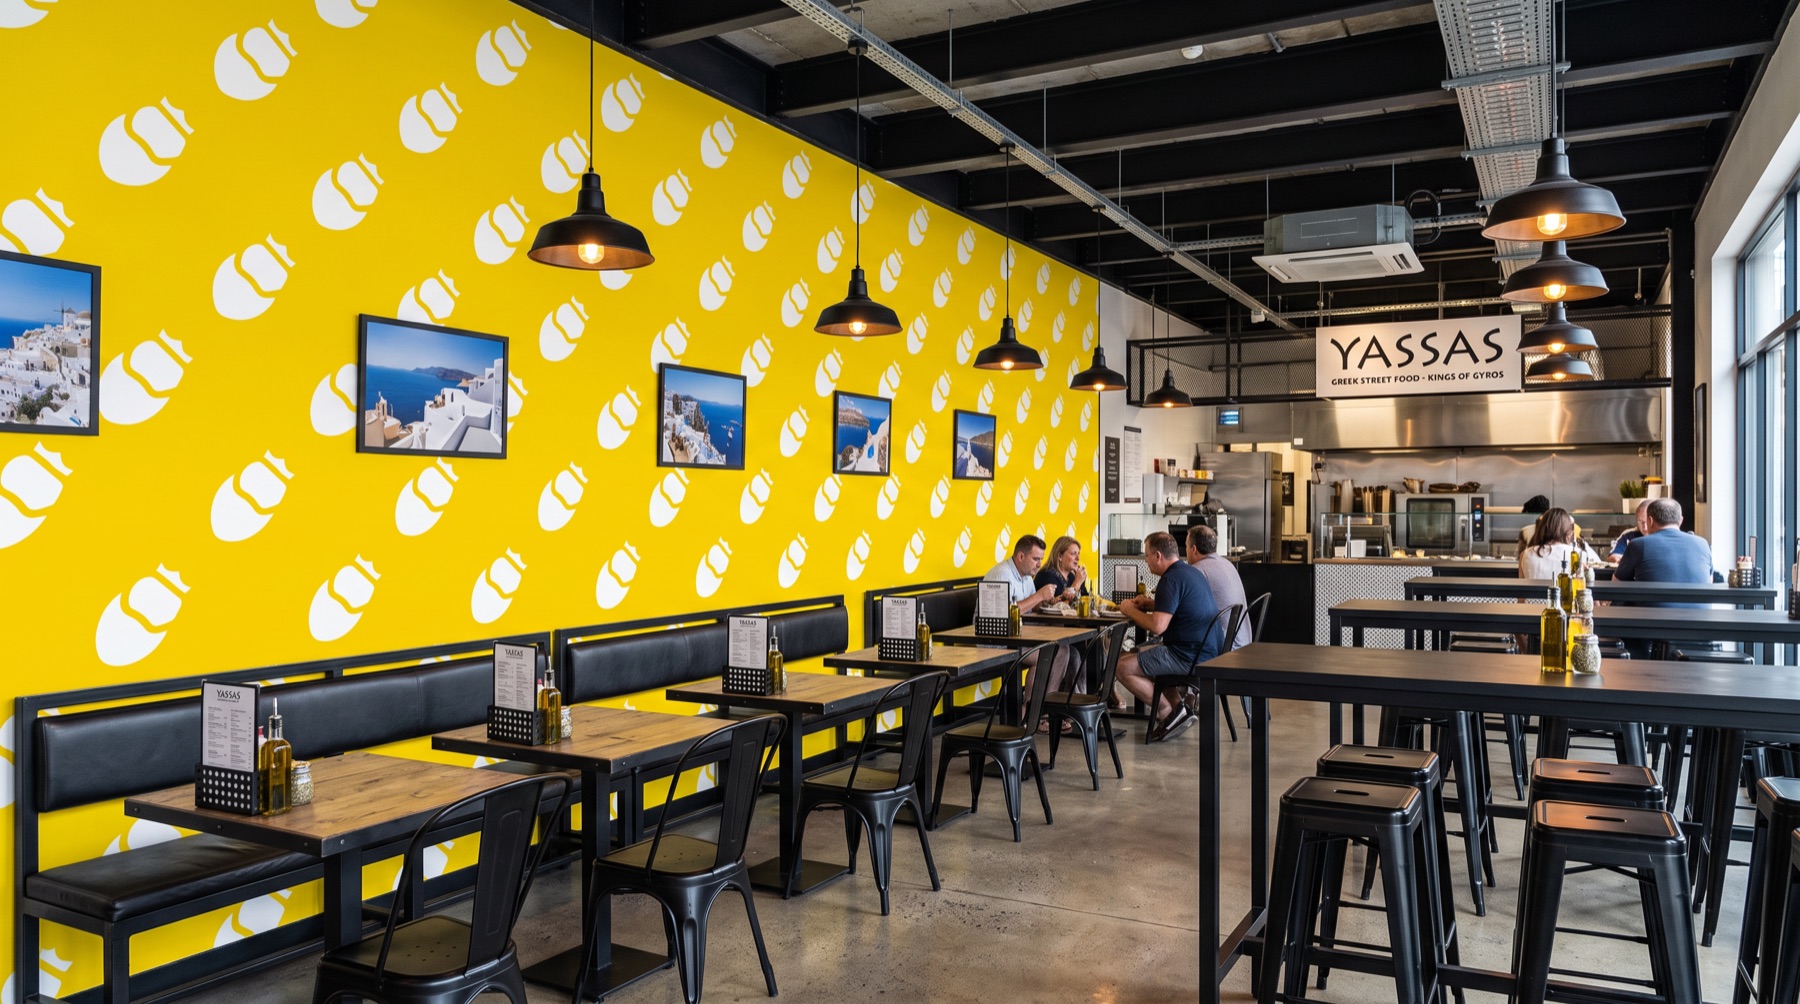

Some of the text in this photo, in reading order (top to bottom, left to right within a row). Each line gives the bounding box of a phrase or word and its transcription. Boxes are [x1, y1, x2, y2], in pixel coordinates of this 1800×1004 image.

[1330, 327, 1504, 370] YASSAS
[1331, 377, 1359, 386] GREEK
[1360, 376, 1392, 385] STREET
[1394, 374, 1420, 383] FOOD
[1427, 372, 1456, 382] KINGS
[1458, 372, 1471, 380] OF
[1472, 370, 1504, 379] GYROS
[217, 689, 241, 699] YASSAS
